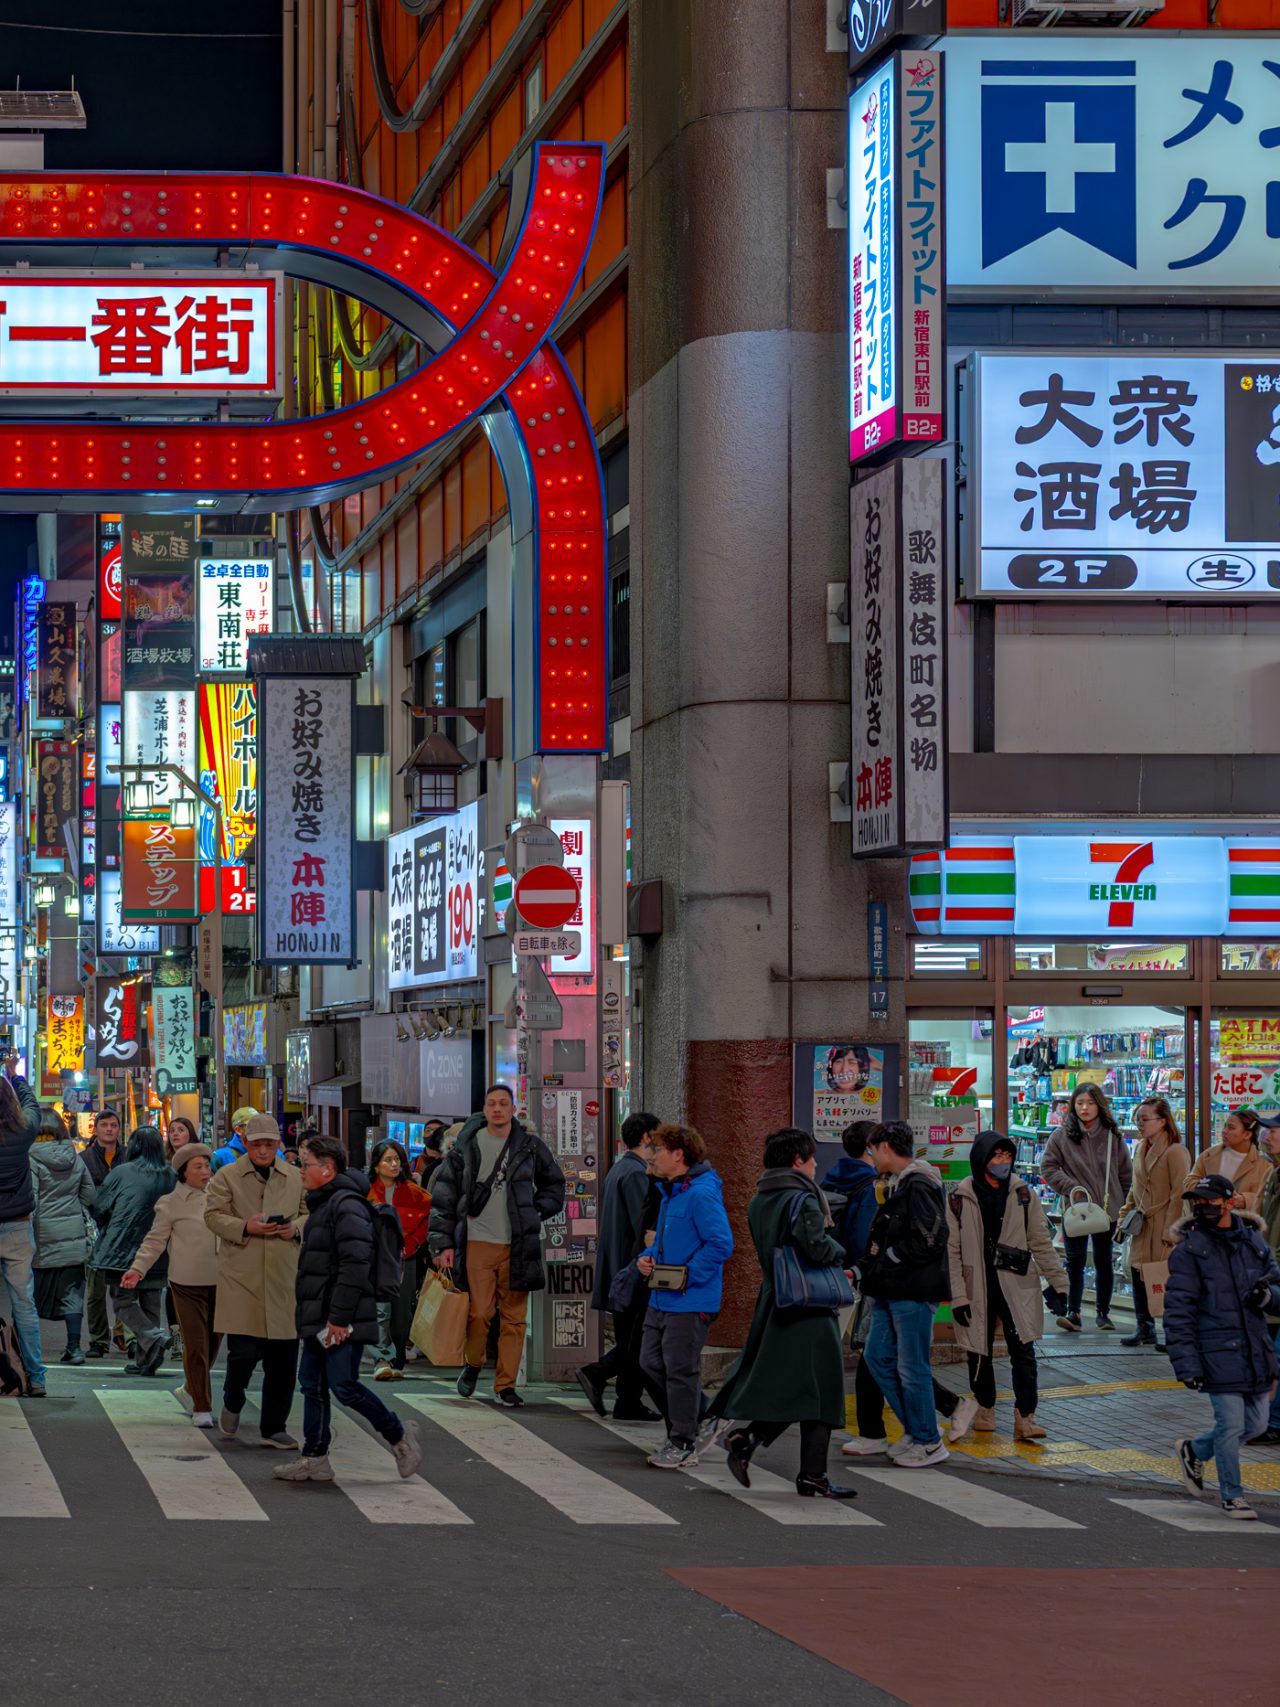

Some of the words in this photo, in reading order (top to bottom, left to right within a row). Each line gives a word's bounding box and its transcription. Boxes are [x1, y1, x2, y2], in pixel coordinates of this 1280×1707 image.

[1163, 60, 1280, 149] メ
[906, 91, 937, 304] ファイトフィット
[1163, 178, 1280, 271] ク
[863, 140, 878, 412] ファイトフィット
[914, 310, 931, 407] 新宿東口駅前
[907, 420, 938, 435] B2F
[1014, 373, 1197, 447] 大衆
[1013, 461, 1198, 535] 酒場
[202, 563, 270, 578] 全卓全自動
[1037, 559, 1110, 583] 2F
[103, 624, 116, 634] 3F
[217, 581, 242, 669] 東南荘
[258, 581, 269, 633] リーチ麻
[863, 496, 884, 749] お好み焼き
[202, 659, 215, 669] 3F
[908, 530, 938, 774] 歌舞伎町名物
[291, 688, 324, 843] お好み焼き
[144, 824, 179, 906] ステップ
[857, 815, 891, 848] HONJIN
[290, 852, 326, 927] 本陣
[448, 882, 474, 949] 190
[276, 932, 341, 954] HONJIN
[519, 936, 576, 952] 自転車を除く
[871, 991, 886, 1003] 17
[168, 993, 193, 1071] お好み焼き
[176, 1082, 196, 1091] B1F
[1213, 1072, 1264, 1095] たばこ
[930, 1130, 947, 1141] SIM
[547, 1264, 594, 1295] NERO
